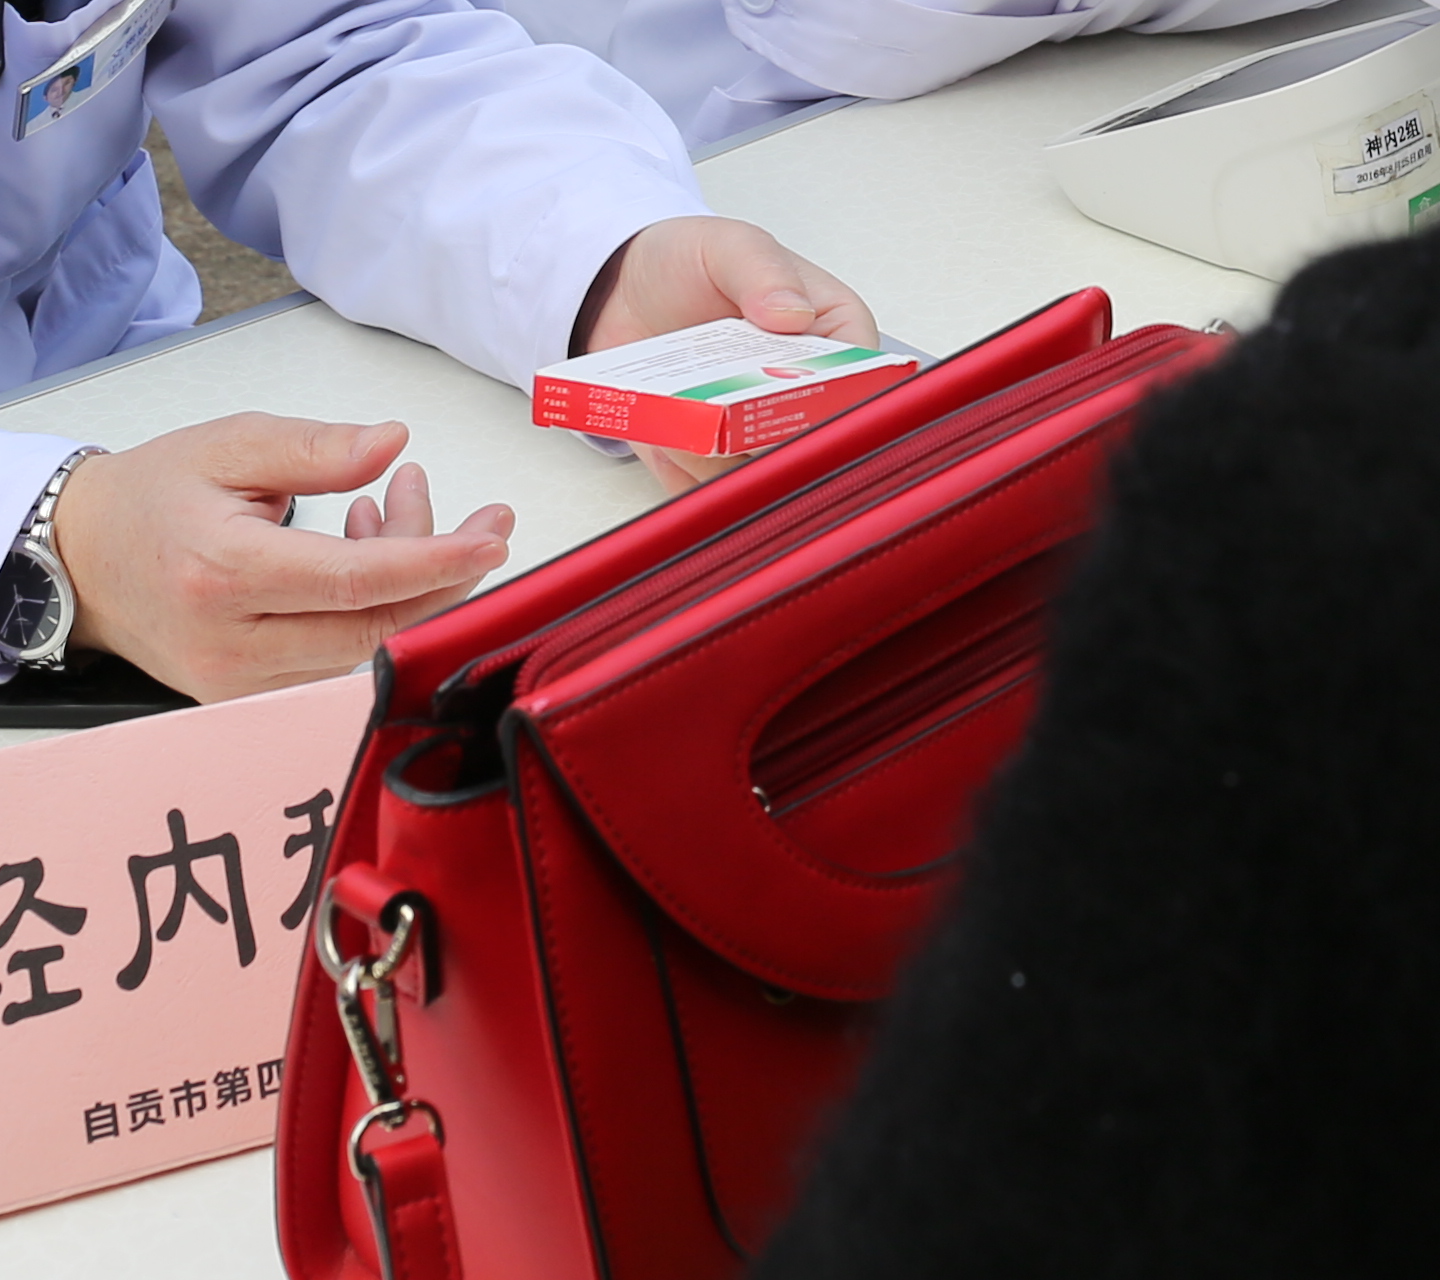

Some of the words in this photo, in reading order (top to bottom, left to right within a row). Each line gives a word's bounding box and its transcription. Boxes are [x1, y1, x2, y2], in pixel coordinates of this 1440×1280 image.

[1365, 117, 1421, 158] 神内2组
[587, 387, 637, 405] 20180419
[585, 414, 629, 431] 2020.03
